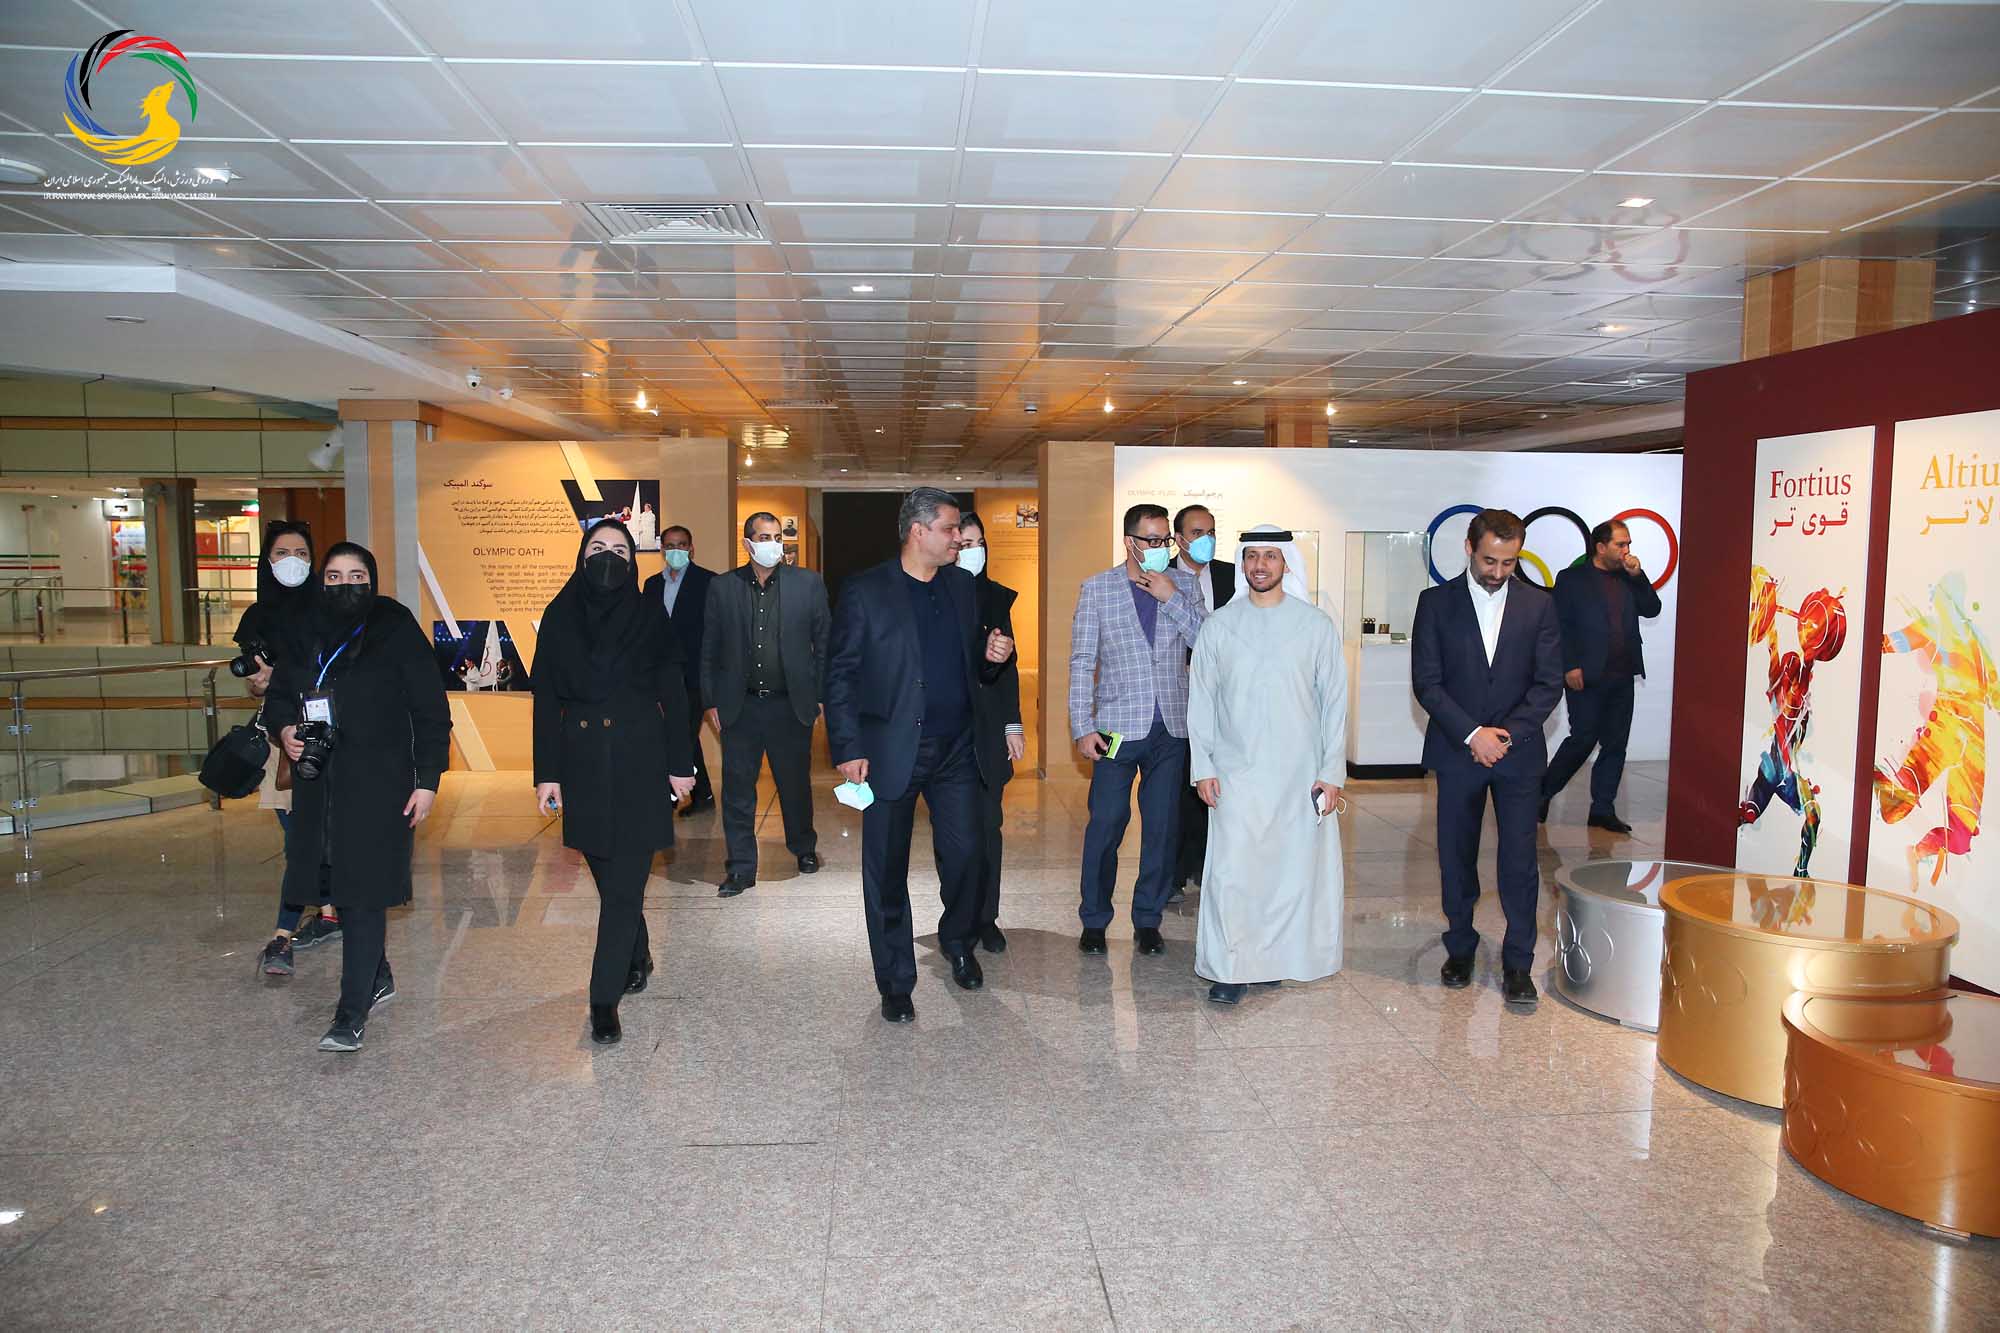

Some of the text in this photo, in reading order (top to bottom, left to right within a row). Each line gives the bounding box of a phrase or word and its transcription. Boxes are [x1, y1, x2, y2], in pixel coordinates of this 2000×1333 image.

[443, 479, 493, 490] سوگند المپیک
[1769, 467, 1852, 499] Fortius
[1919, 453, 2000, 490] Altiu
[1769, 501, 1849, 537] قوی تر
[472, 547, 545, 557] OLYMPIC OATH
